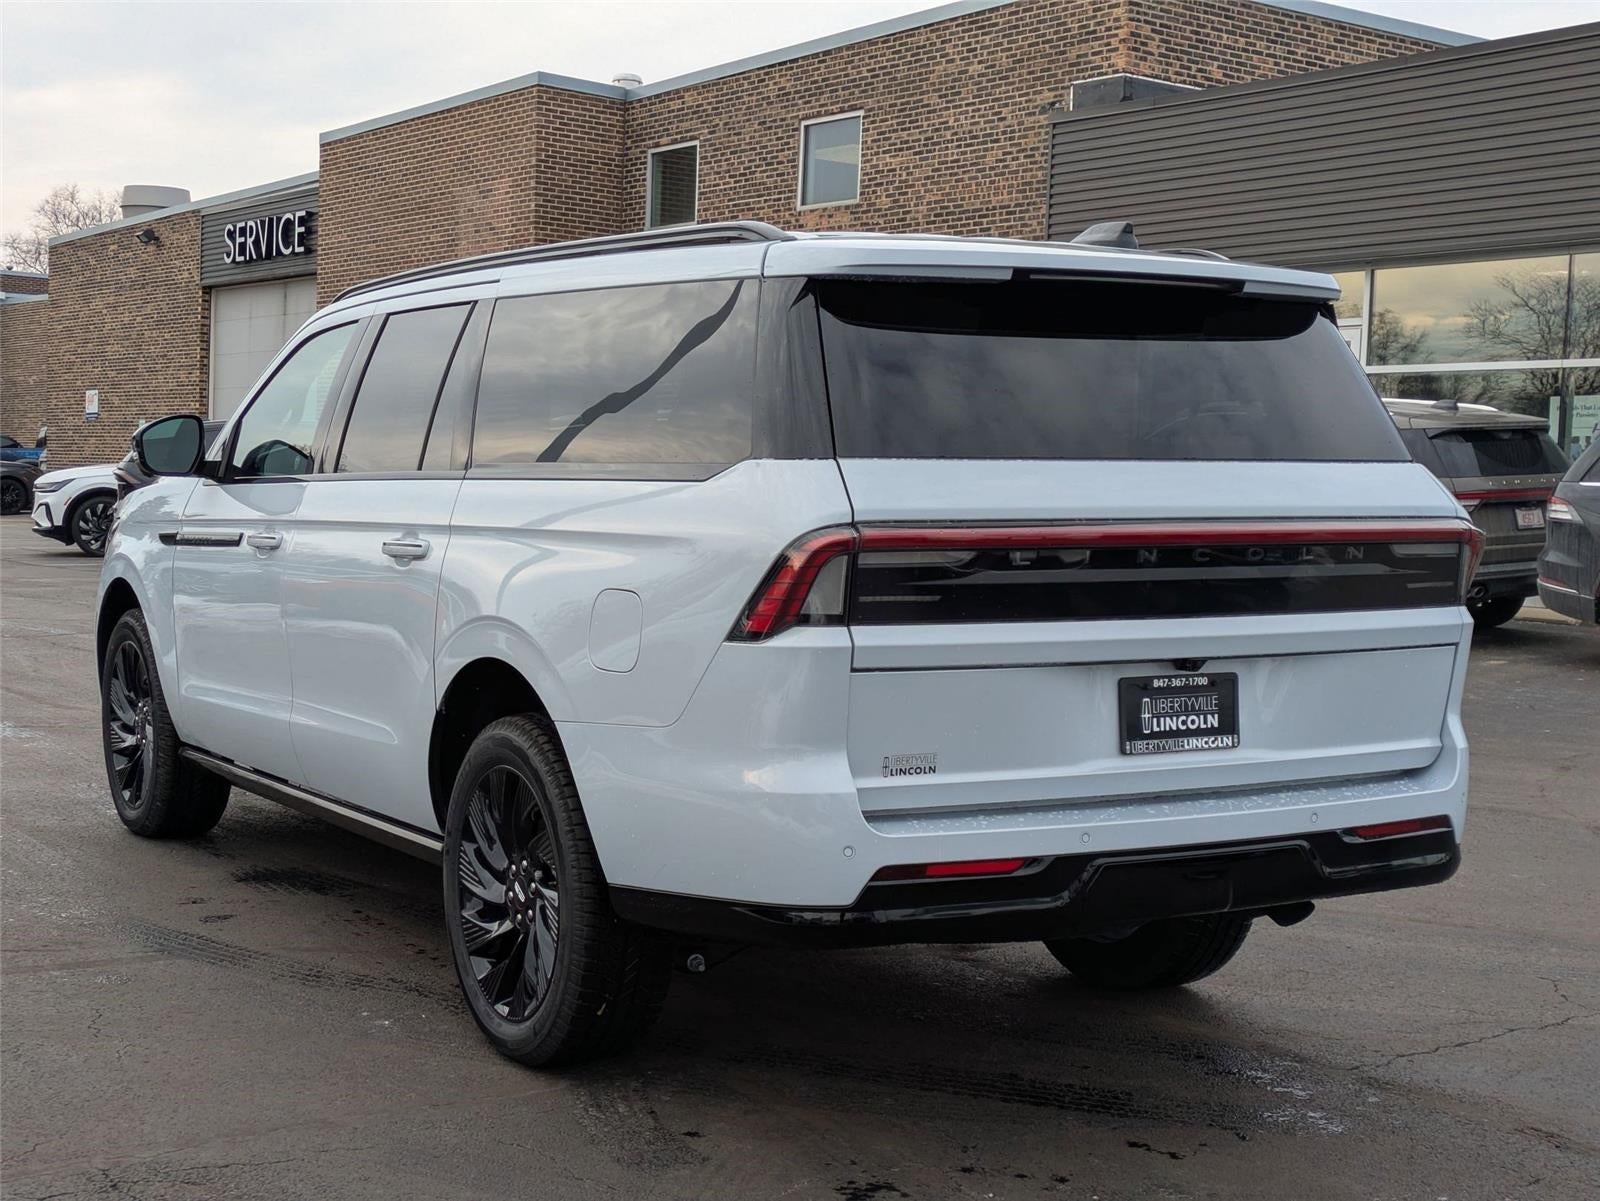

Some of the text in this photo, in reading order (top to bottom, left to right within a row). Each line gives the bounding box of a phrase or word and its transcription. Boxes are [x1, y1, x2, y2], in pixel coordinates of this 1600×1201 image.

[223, 210, 307, 264] SERVICE
[1010, 546, 1366, 566] LINCOLN
[1153, 677, 1208, 688] 847-367-1700
[1152, 695, 1219, 714] LIBERTYVILLE
[1153, 713, 1219, 732] LINCOLN
[890, 765, 937, 777] LINCOLN
